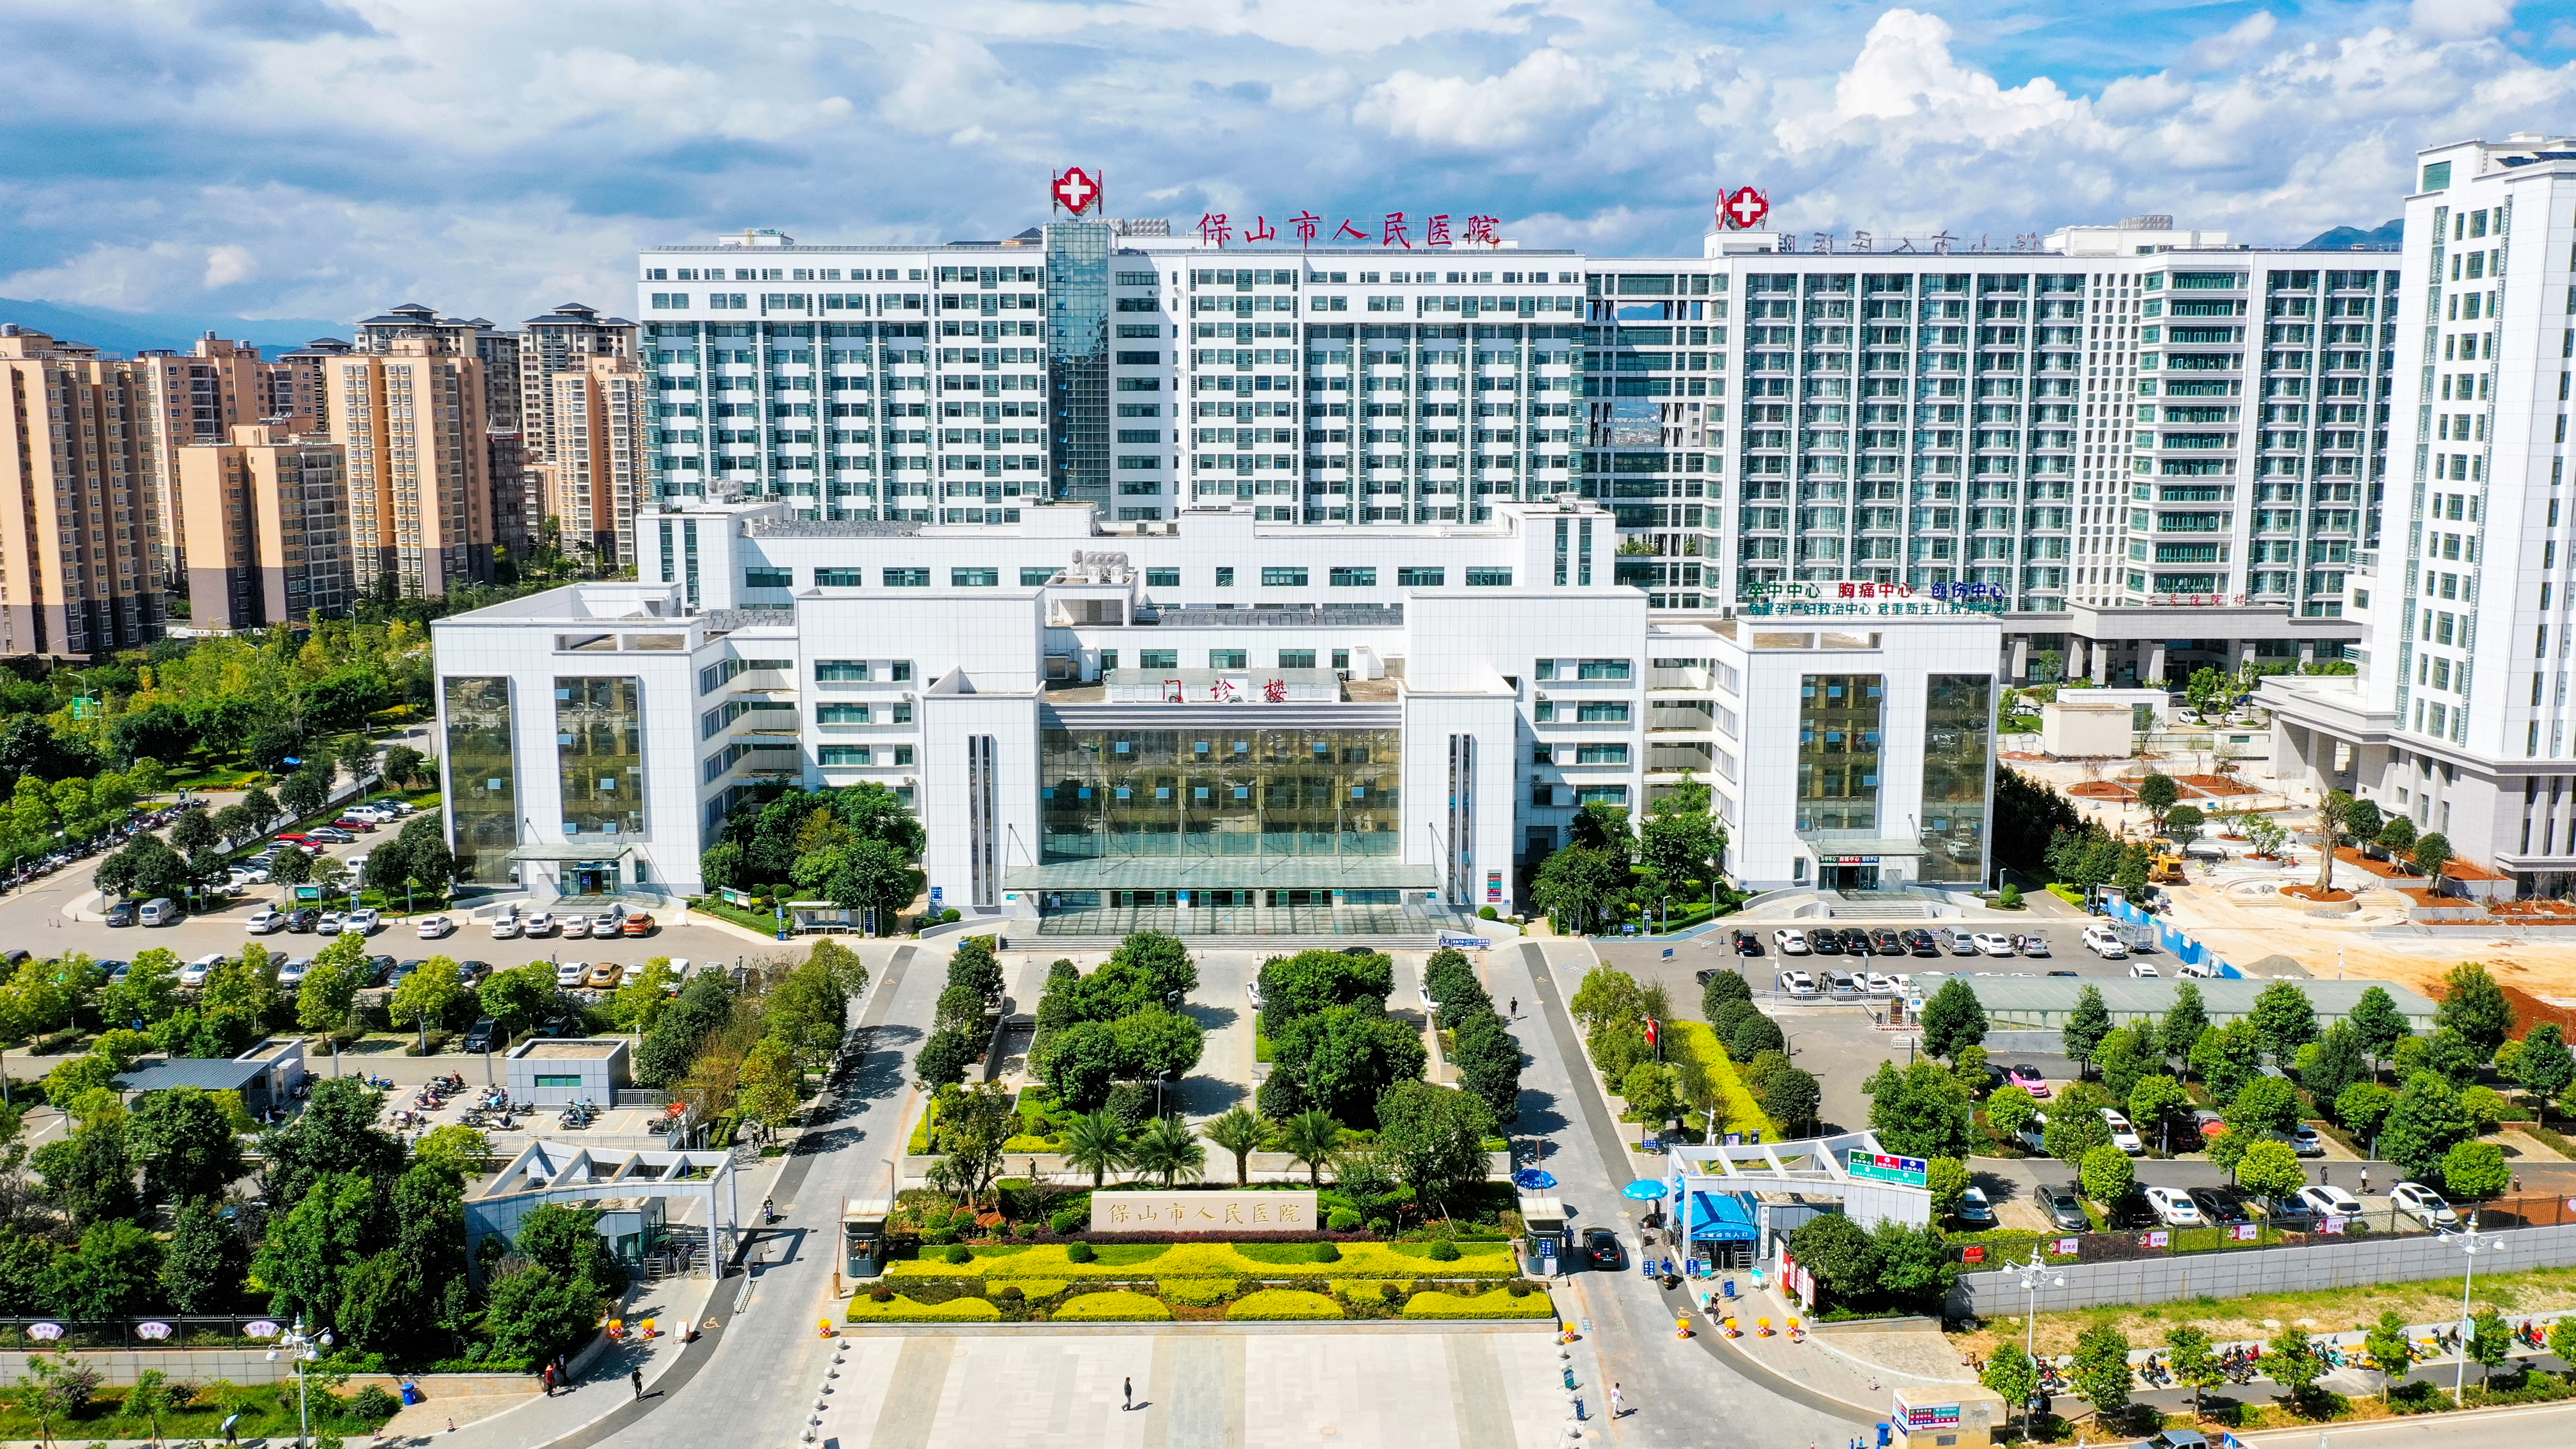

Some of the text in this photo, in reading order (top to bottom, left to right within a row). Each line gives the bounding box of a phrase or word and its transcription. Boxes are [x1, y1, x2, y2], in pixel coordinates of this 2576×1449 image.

[1197, 212, 1501, 250] 保山市人民医院
[1748, 582, 2005, 599] 卒中中心 胸痛中心 创伤中心
[2147, 593, 2248, 607] 二号住院楼
[1748, 602, 2005, 615] 危重孕产妇救治中心 危重新生儿救治中心
[1162, 678, 1288, 703] 门诊楼
[1107, 1202, 1301, 1226] 保山市人民医院
